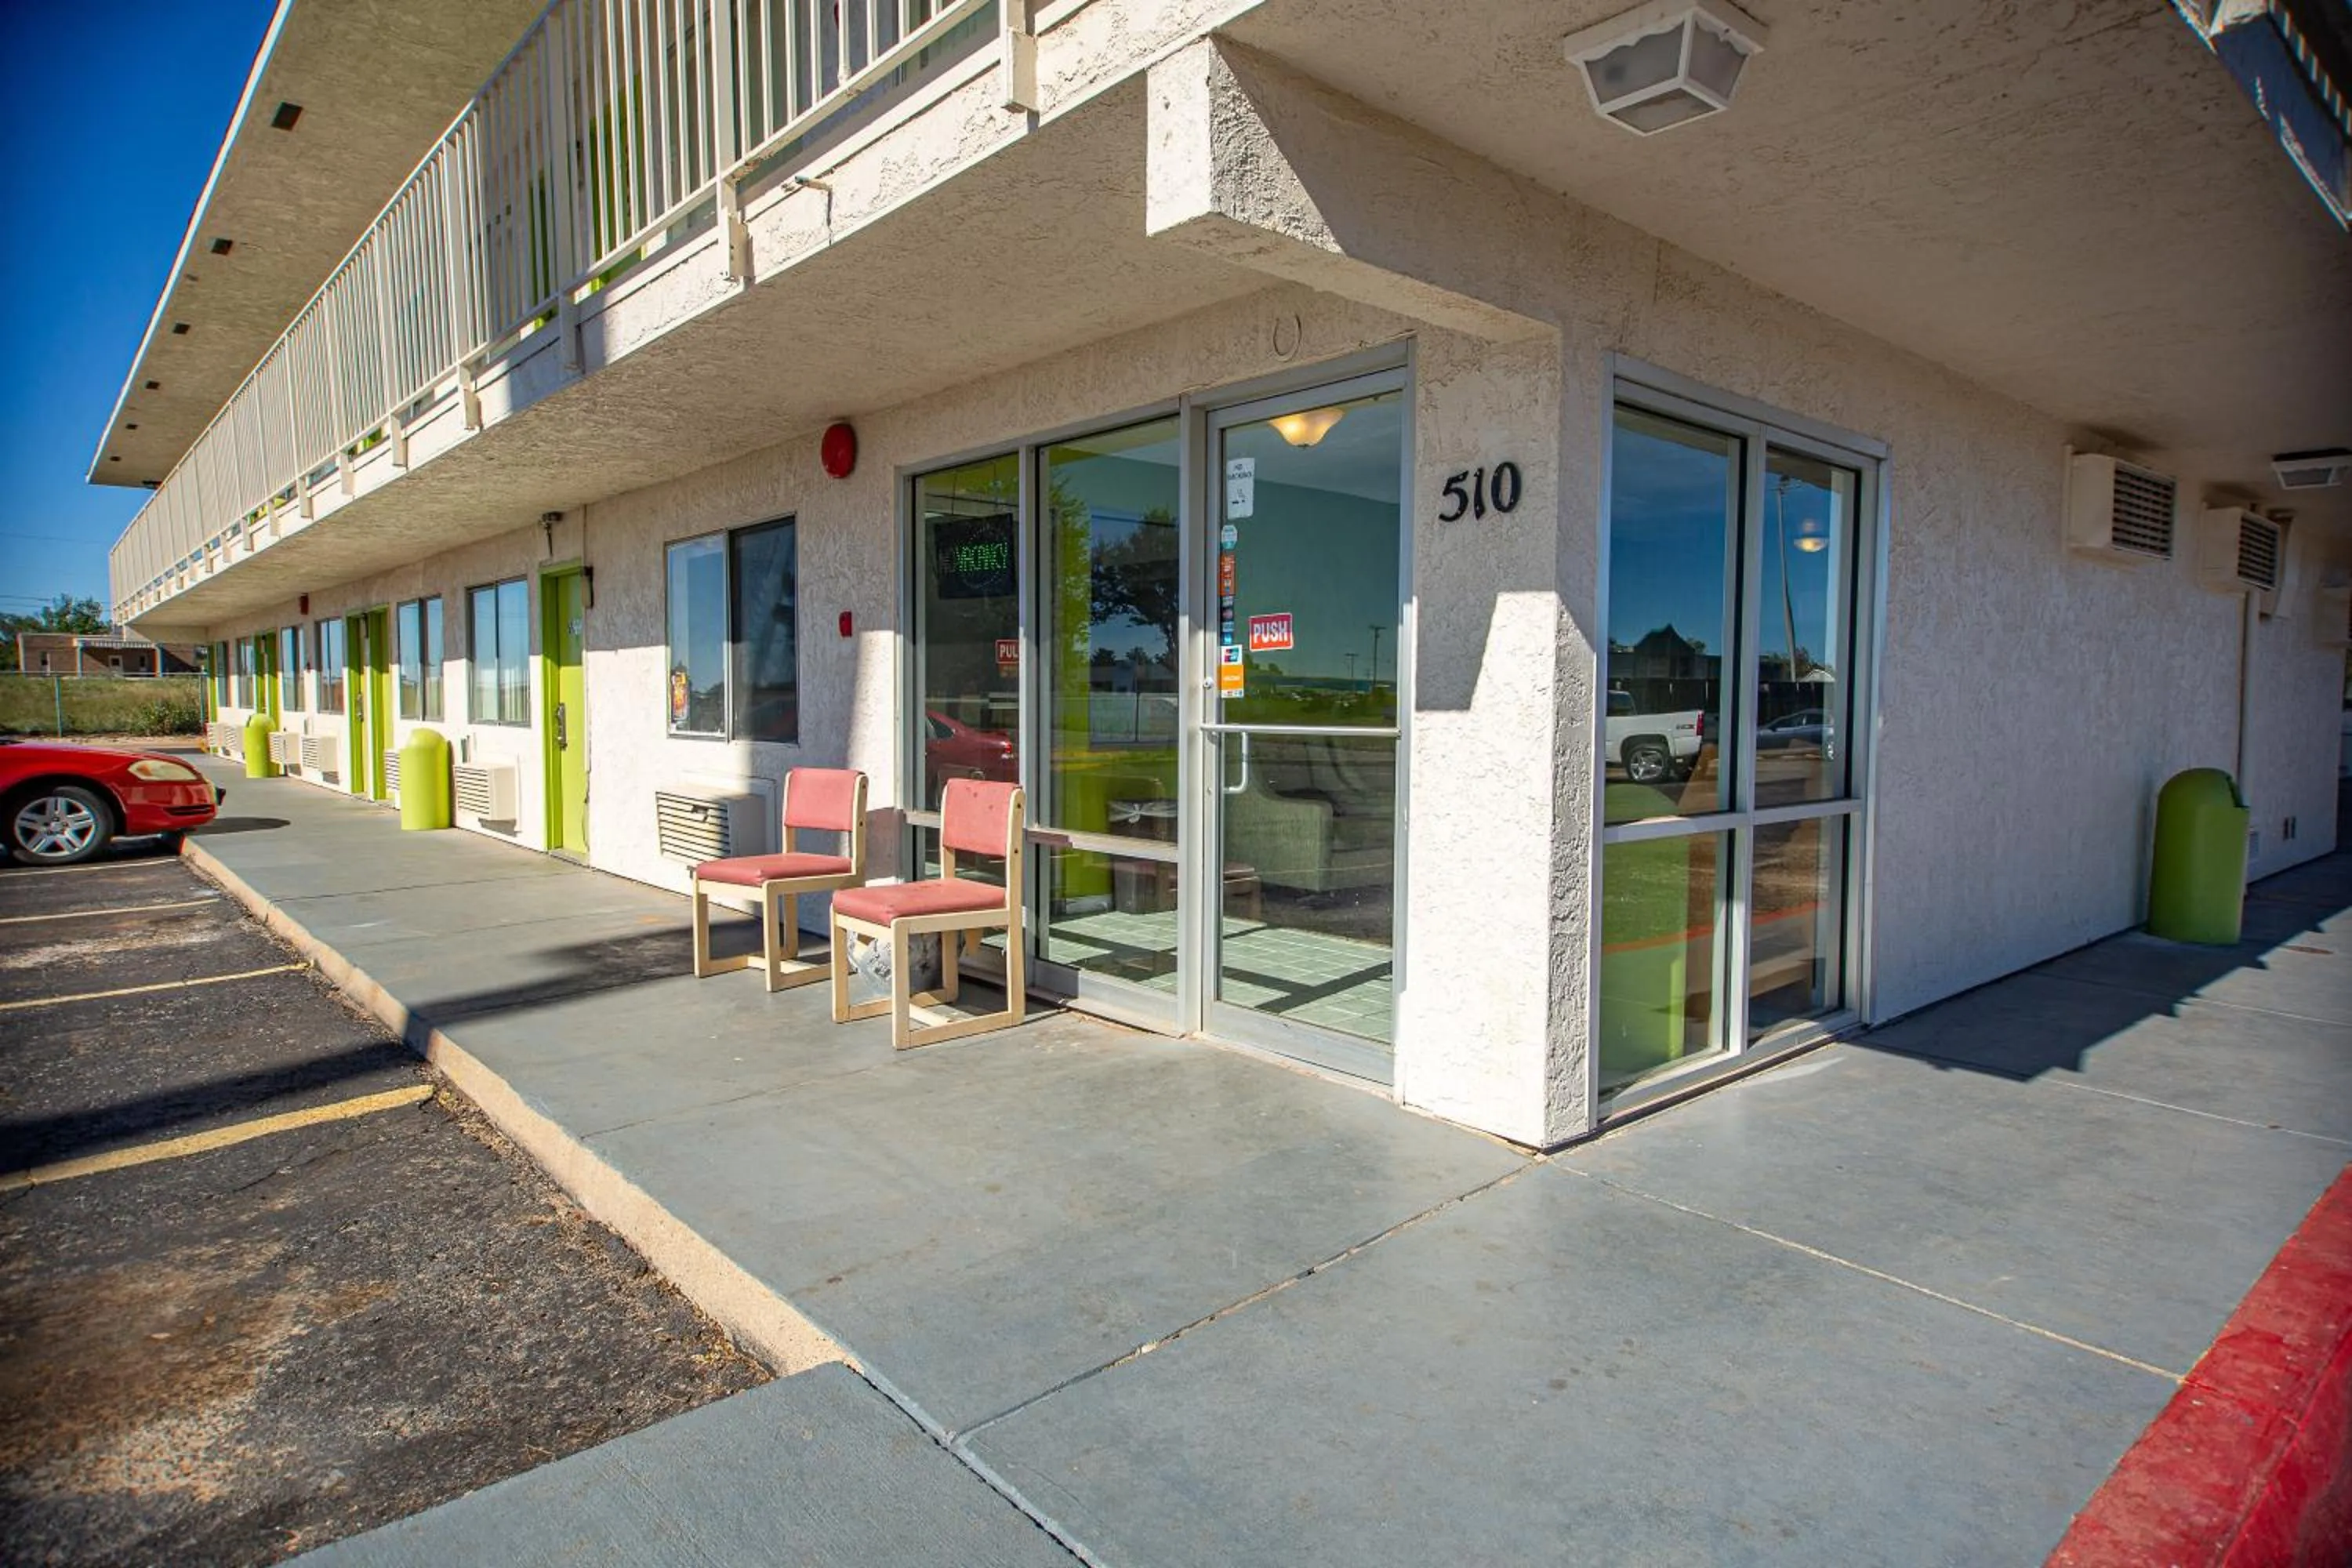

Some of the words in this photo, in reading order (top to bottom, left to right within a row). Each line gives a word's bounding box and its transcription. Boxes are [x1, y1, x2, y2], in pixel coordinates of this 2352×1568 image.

[1439, 462, 1522, 522] 510
[1254, 620, 1288, 644] PUSH
[1000, 644, 1018, 658] PUL
